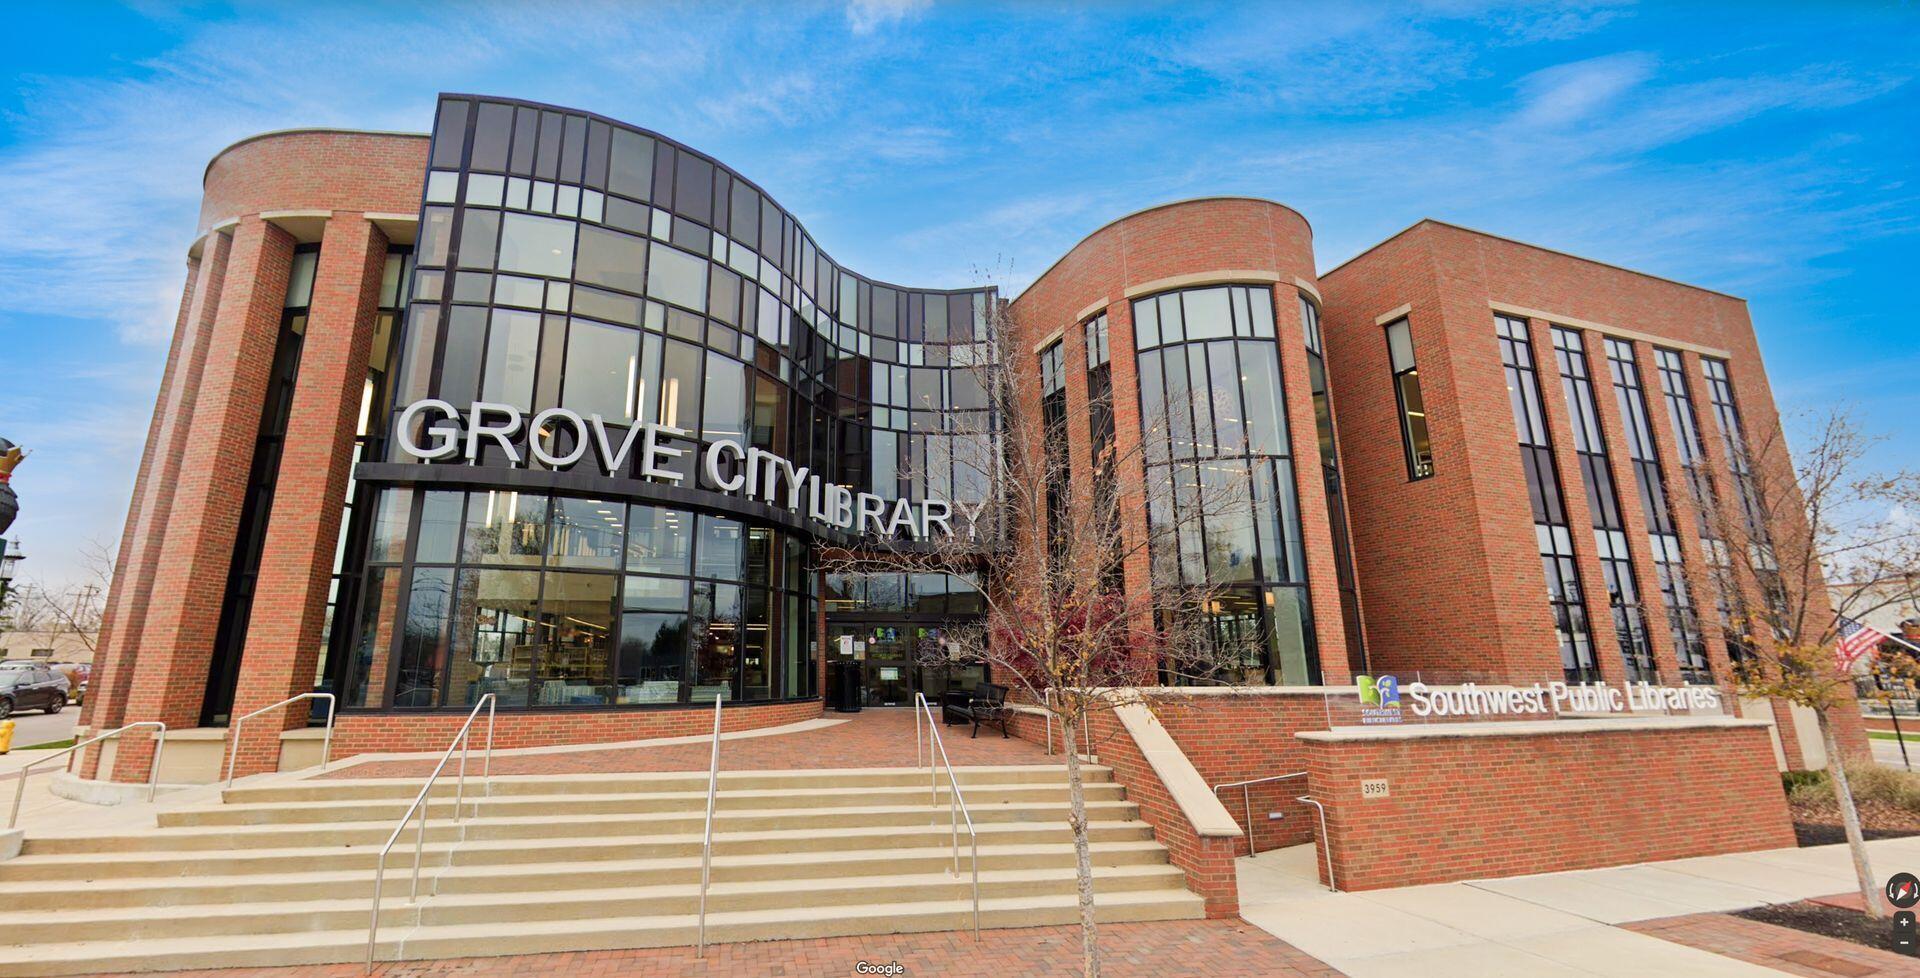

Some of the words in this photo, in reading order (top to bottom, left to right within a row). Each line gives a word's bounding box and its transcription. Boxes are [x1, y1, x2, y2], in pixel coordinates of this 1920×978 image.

[397, 399, 686, 481] GROVE
[706, 439, 809, 509] CITY
[809, 475, 987, 538] LIBRARY
[1408, 682, 1548, 716] Southwest
[1549, 680, 1624, 712] Public
[1625, 680, 1718, 711] Libraries
[1364, 783, 1387, 794] 3959
